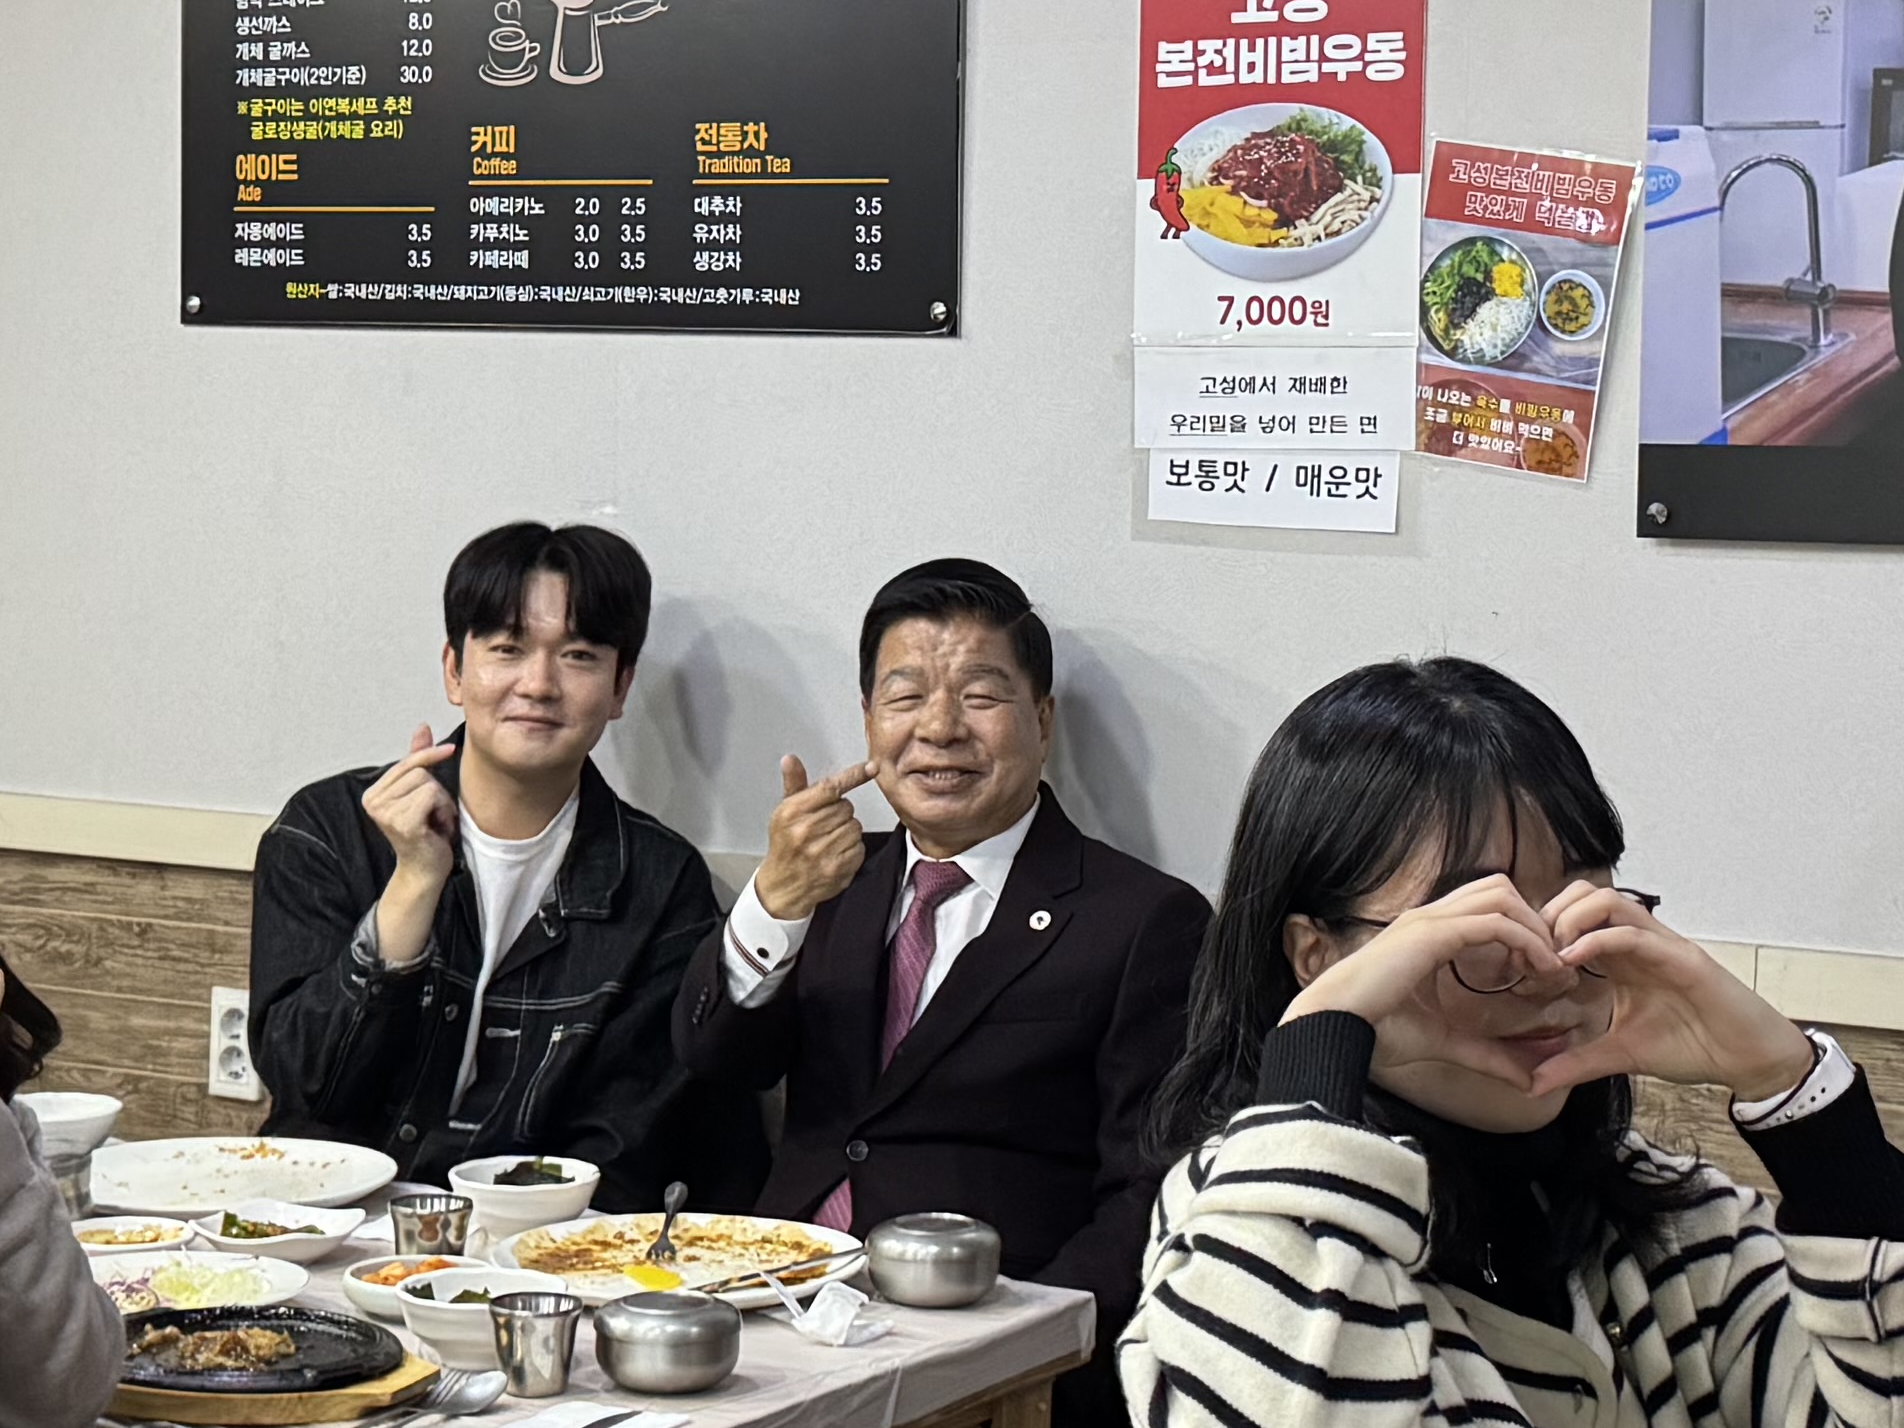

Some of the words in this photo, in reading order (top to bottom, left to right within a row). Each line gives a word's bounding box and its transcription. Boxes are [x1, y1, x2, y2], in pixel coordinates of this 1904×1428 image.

[235, 16, 291, 35] 생선까스
[408, 13, 433, 31] 8.0
[235, 42, 263, 60] 개체
[268, 41, 311, 60] 굴까스
[401, 39, 433, 57] 12.0
[1155, 31, 1407, 89] 본전비빔우동
[235, 65, 366, 87] 개체굴구이(2인기준)
[399, 66, 433, 84] 30.0
[382, 96, 412, 115] 추천
[369, 120, 404, 139] 요리)
[470, 124, 516, 154] 커피
[694, 121, 768, 152] 전통차
[235, 153, 299, 181] 에이드
[472, 157, 517, 175] Coffee
[697, 155, 761, 174] Tradition
[765, 155, 791, 174] Tea
[1449, 159, 1617, 204] 고성본전비빔우동
[237, 184, 262, 202] Ade
[469, 196, 545, 216] 아메리카노
[574, 197, 600, 215] 2.0
[620, 197, 646, 215] 2.5
[693, 195, 742, 216] 대추차
[855, 196, 882, 216] 3.5
[1464, 191, 1528, 223] 맛있게
[234, 222, 305, 241] 자몽에이드
[407, 223, 432, 242] 3.5
[469, 223, 529, 243] 카푸치노
[574, 224, 600, 243] 3.0
[620, 224, 646, 243] 3.5
[692, 223, 742, 244] 유자차
[855, 225, 882, 244] 3.5
[234, 248, 305, 267] 레몬에이드
[407, 250, 432, 268] 3.5
[469, 249, 529, 269] 카페라떼
[574, 251, 600, 269] 3.0
[620, 251, 646, 270] 3.5
[693, 251, 742, 271] 생강차
[855, 253, 882, 272] 3.5
[1217, 295, 1330, 332] 7,000원
[1199, 375, 1276, 395] 고성에서
[1288, 376, 1348, 395] 재배한
[1437, 388, 1472, 407] 나오는
[1169, 414, 1247, 433] 우리밀을
[1258, 414, 1296, 434] 넣어
[1308, 415, 1348, 434] 만든
[1360, 415, 1378, 434] 면
[1165, 458, 1250, 493] 보통맛
[1265, 463, 1279, 493] /
[1295, 464, 1382, 500] 매운맛
